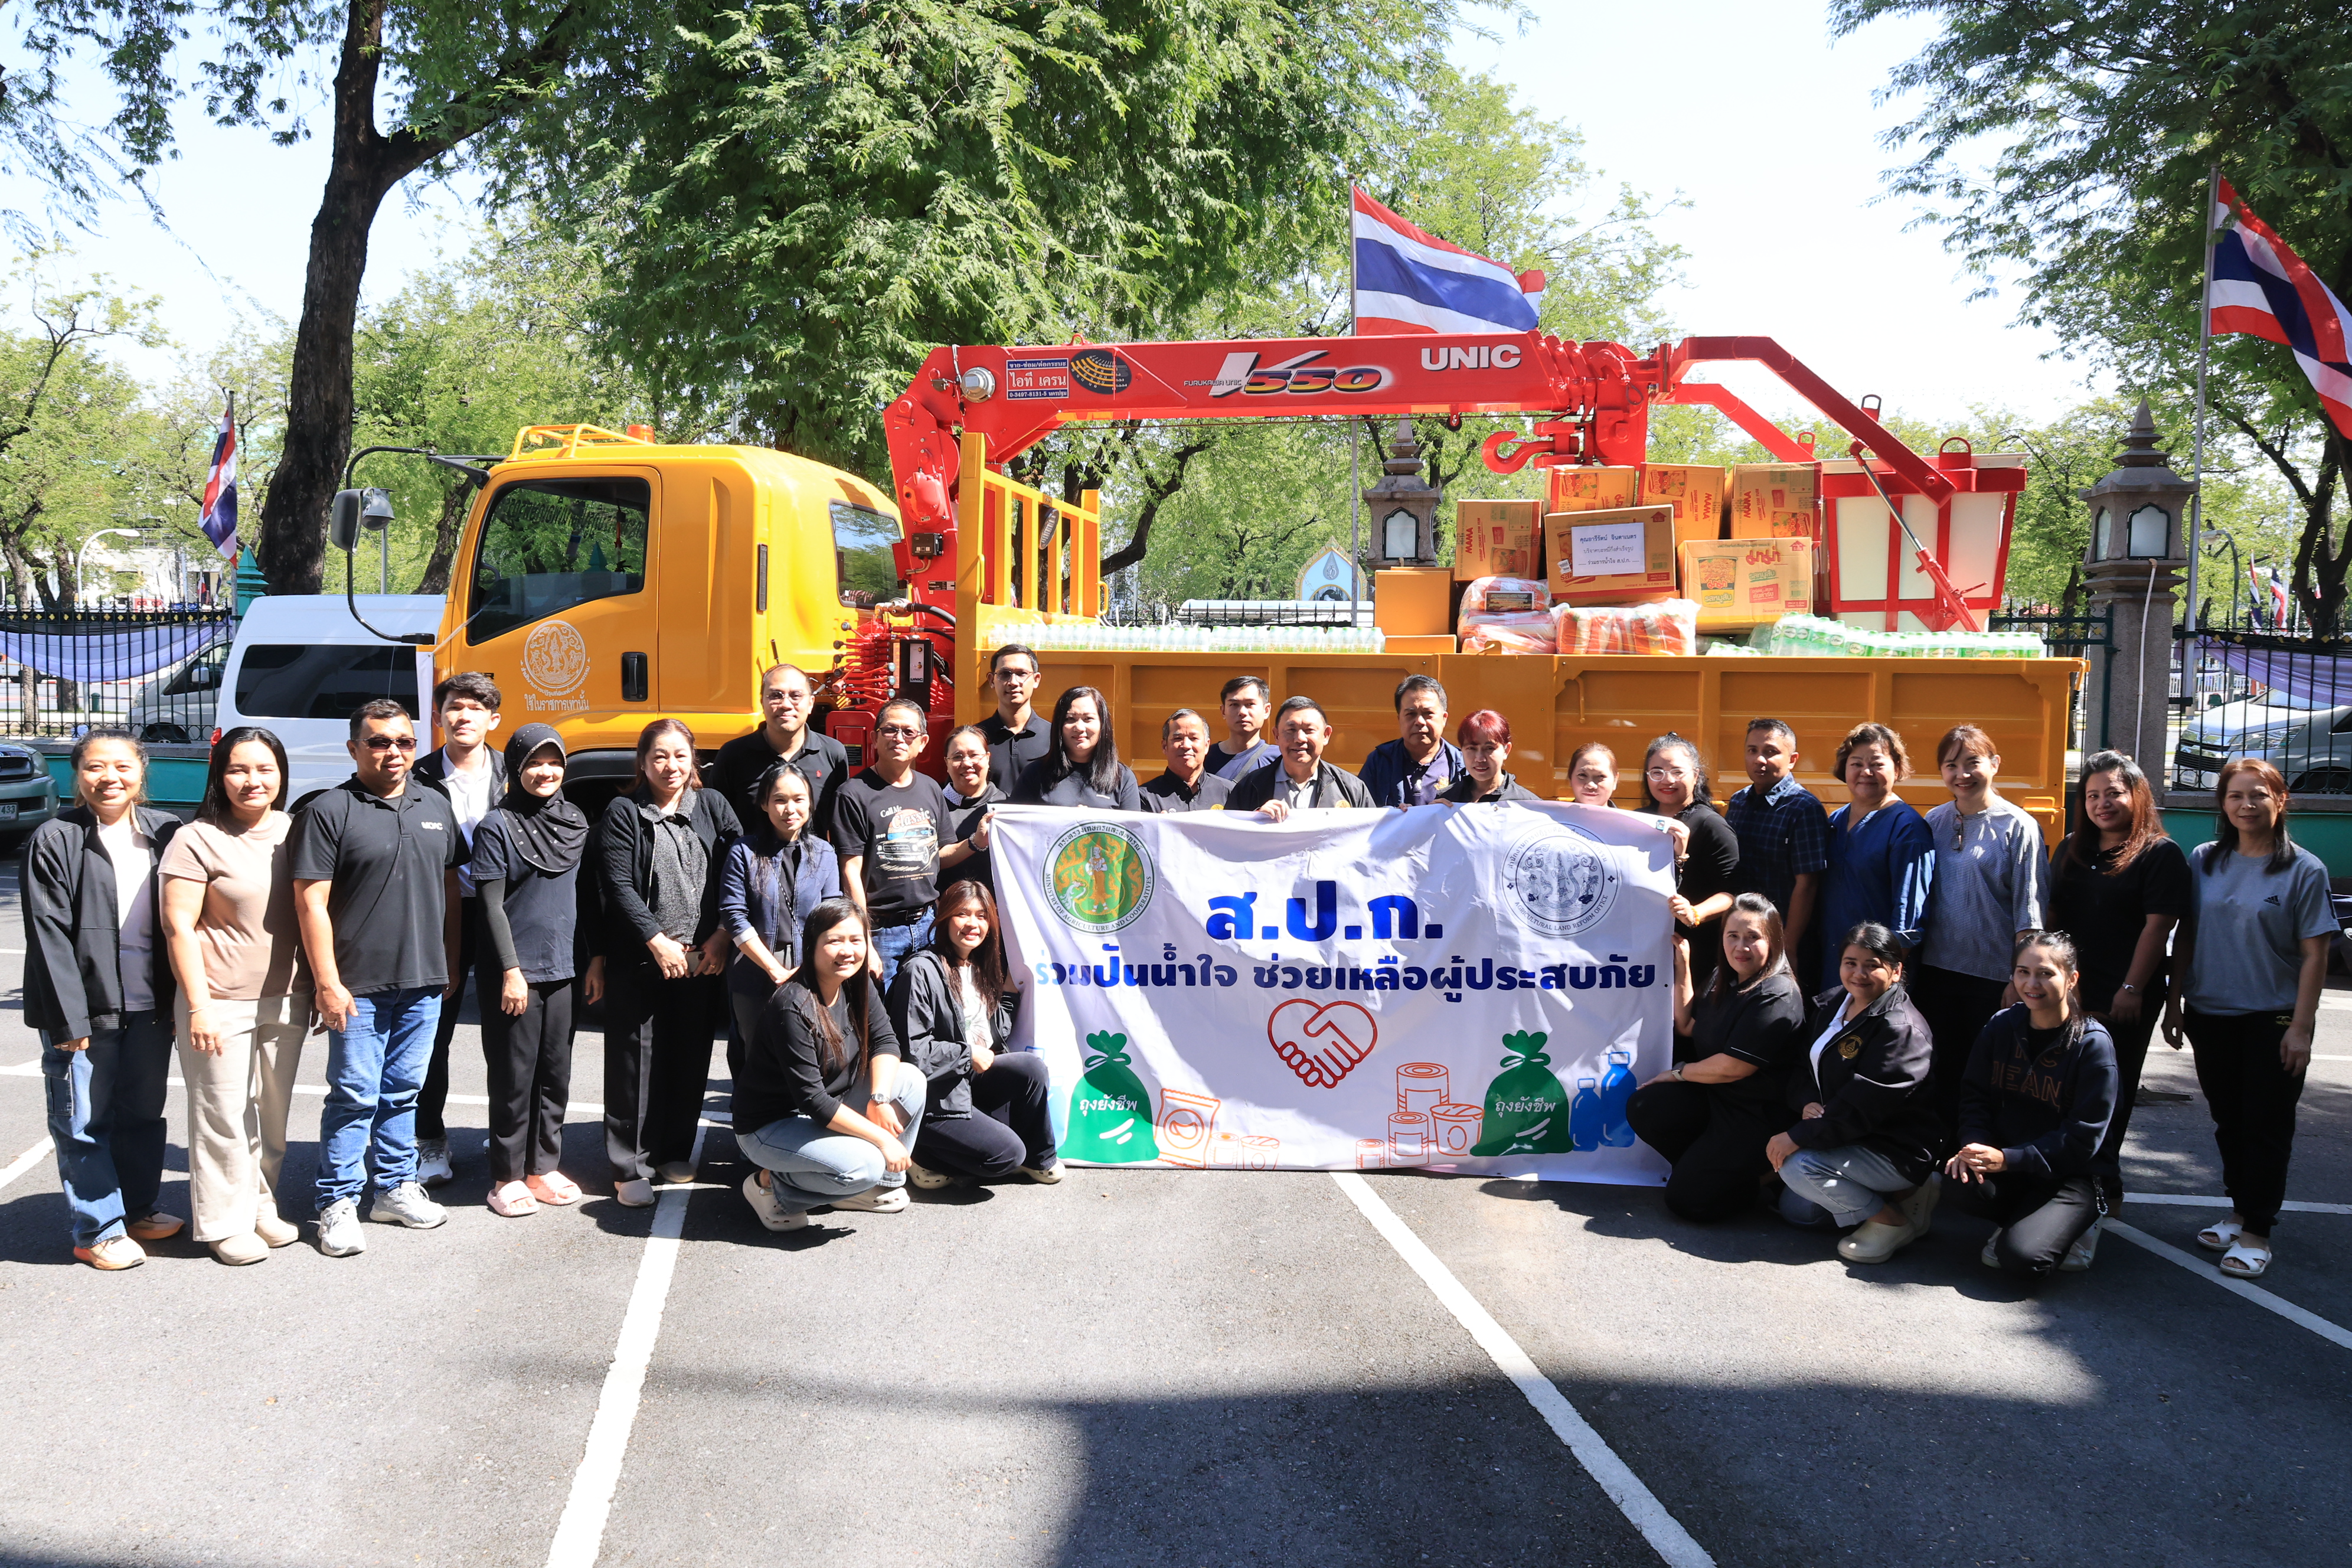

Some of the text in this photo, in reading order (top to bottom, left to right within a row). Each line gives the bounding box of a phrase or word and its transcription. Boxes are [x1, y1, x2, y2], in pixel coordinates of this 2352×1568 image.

[1421, 344, 1521, 371] UNIC
[1010, 371, 1066, 387] ไอที เครน
[1703, 493, 1712, 520] MAMA
[1743, 491, 1752, 518] MAMA
[1465, 527, 1473, 554] MAMA
[1749, 569, 1776, 580] รสหมูสับ
[1704, 592, 1733, 603] รสหมูสับ
[524, 690, 590, 711] ใช้ในราชการเท่านั้น
[0, 805, 15, 814] 433
[880, 806, 894, 818] Call
[891, 808, 930, 829] Classic
[1057, 825, 1144, 851] กระทรวงเกษตรและสหกรณ์
[1046, 873, 1152, 931] MINISTRY OF AGRICULTURE AND COOPERATIVES
[1206, 880, 1443, 942] ส.ป.ก.
[1514, 901, 1553, 930] AGRICULTURAL
[1573, 913, 1596, 929] REFORM
[1593, 894, 1608, 914] OFFICE
[1035, 943, 1655, 1003] ร่วมปันน้ำใจ ช่วยเหลือผู้ประสบภัย
[1079, 1094, 1138, 1117] ถุงยังชีพ
[1495, 1096, 1556, 1118] ถุงยังชีพ
